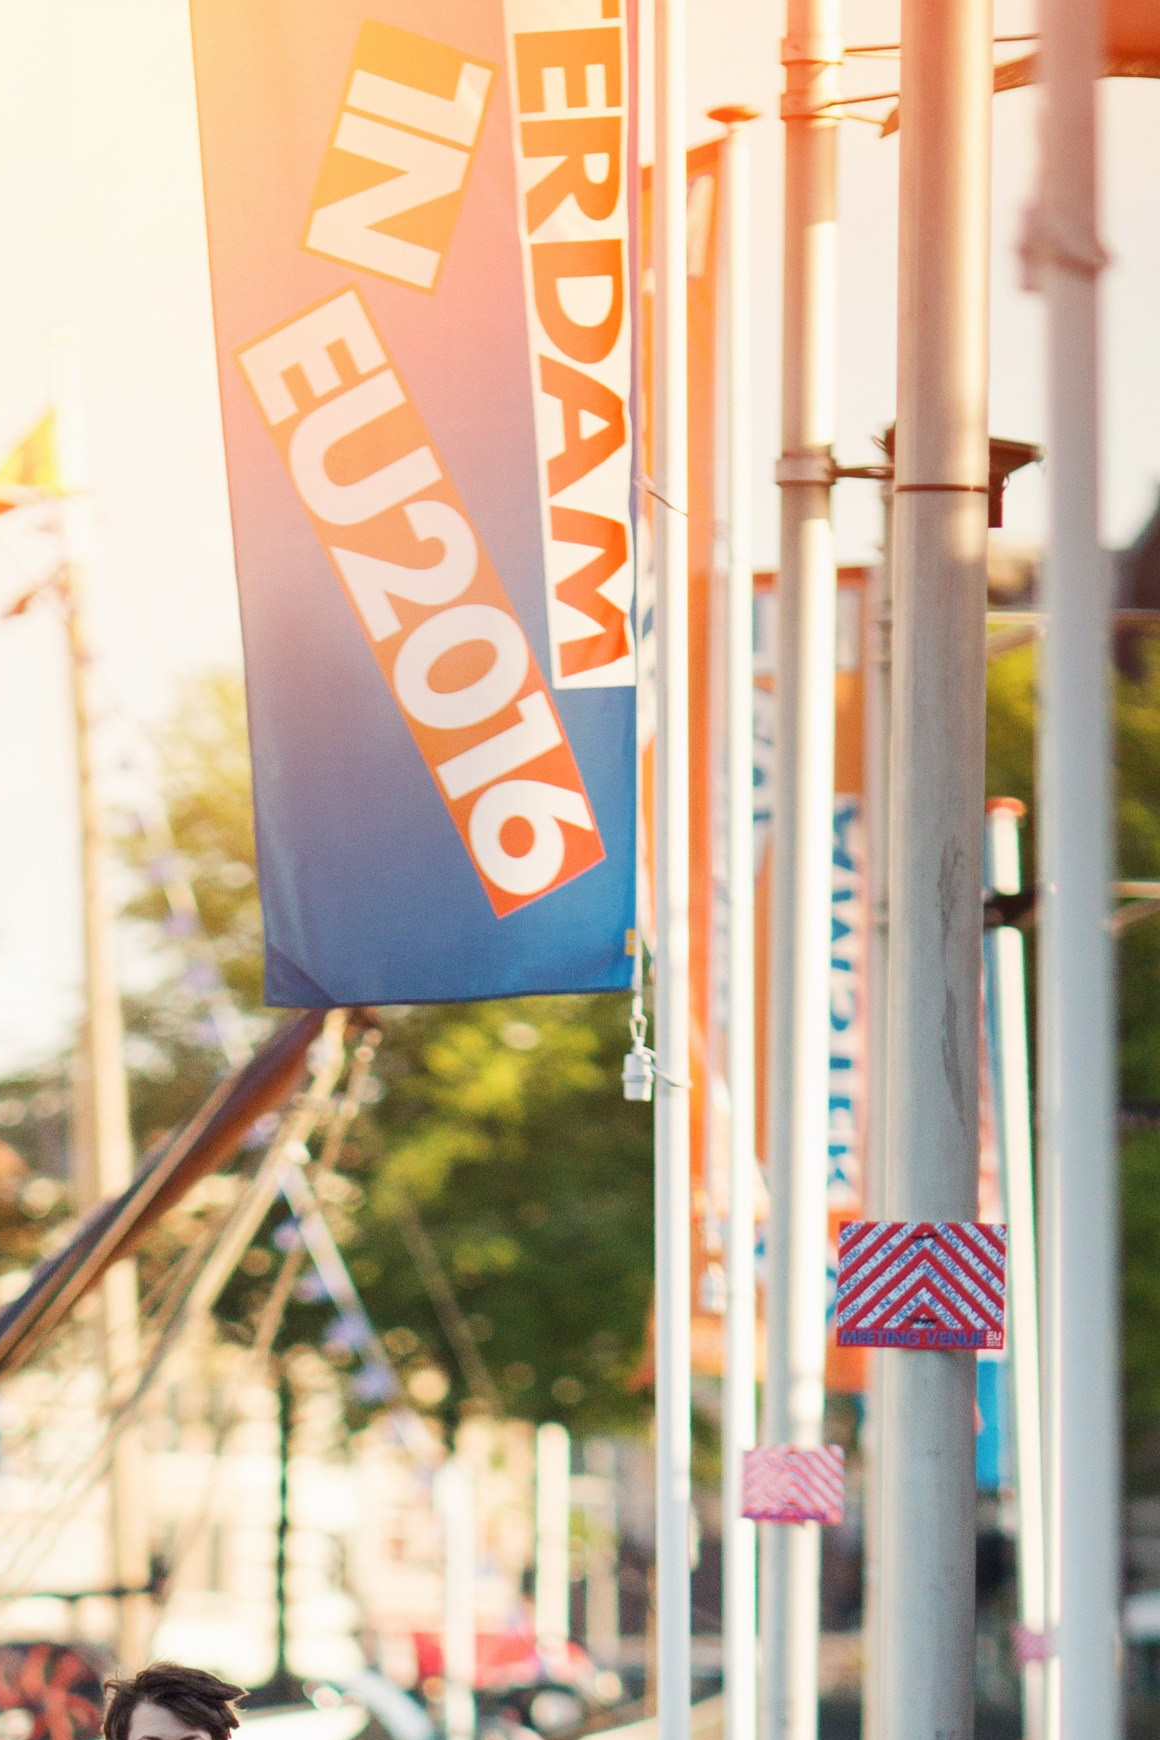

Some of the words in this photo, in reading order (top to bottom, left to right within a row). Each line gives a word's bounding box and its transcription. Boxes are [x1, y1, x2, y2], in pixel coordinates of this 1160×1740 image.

[304, 62, 495, 290] NL
[514, 0, 633, 678] ERDAM
[239, 289, 595, 897] EU2016
[841, 1330, 920, 1346] MEETING
[927, 1330, 983, 1347] VENUE
[987, 1331, 1002, 1341] EU
